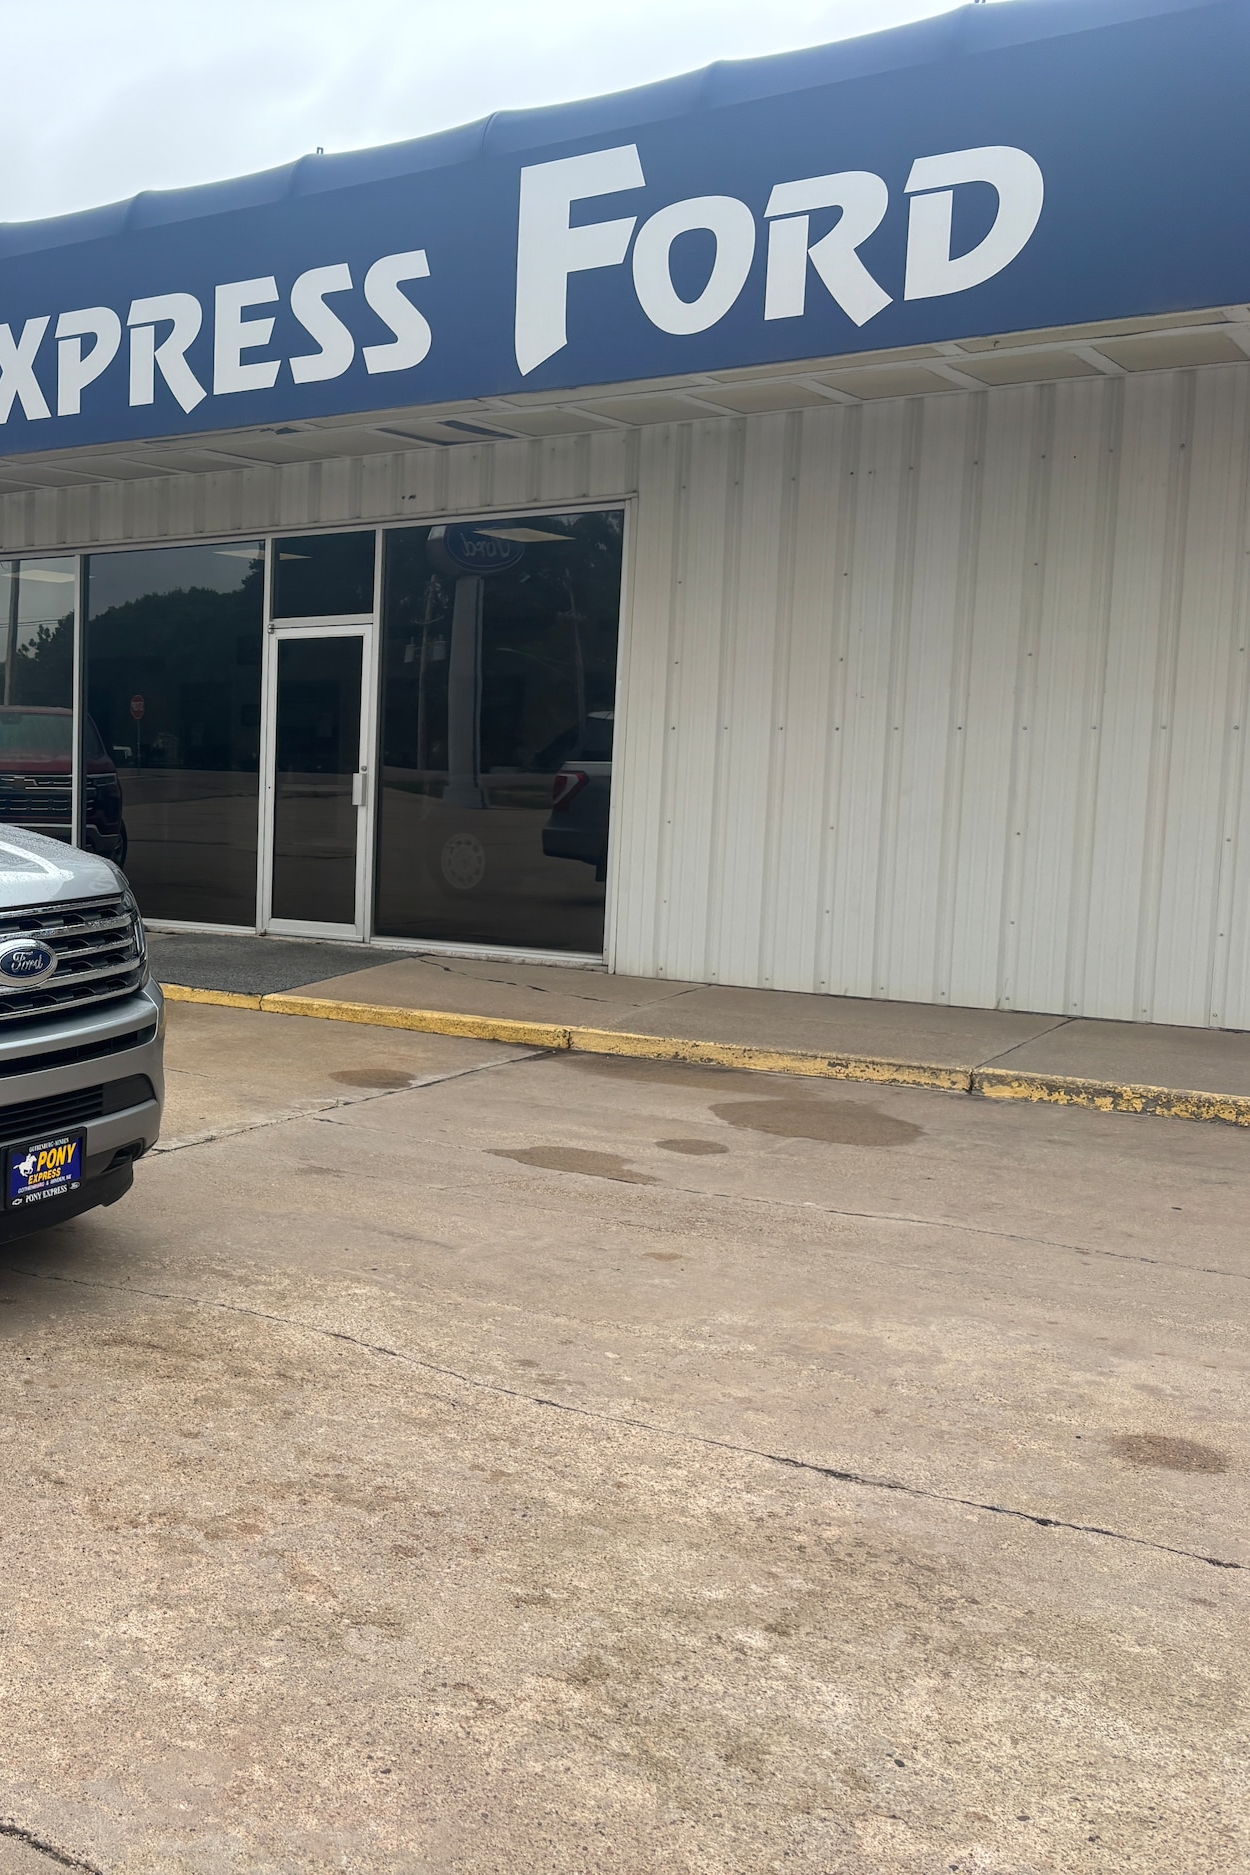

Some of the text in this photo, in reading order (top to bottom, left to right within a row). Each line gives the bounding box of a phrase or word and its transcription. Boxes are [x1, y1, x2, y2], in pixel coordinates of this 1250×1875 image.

[514, 144, 1044, 377] FORD
[11, 951, 44, 972] Ford
[37, 1142, 77, 1172] PONY
[28, 1168, 61, 1185] EXPRESS
[25, 1191, 42, 1203] PONY
[42, 1185, 68, 1199] EXPRESS
